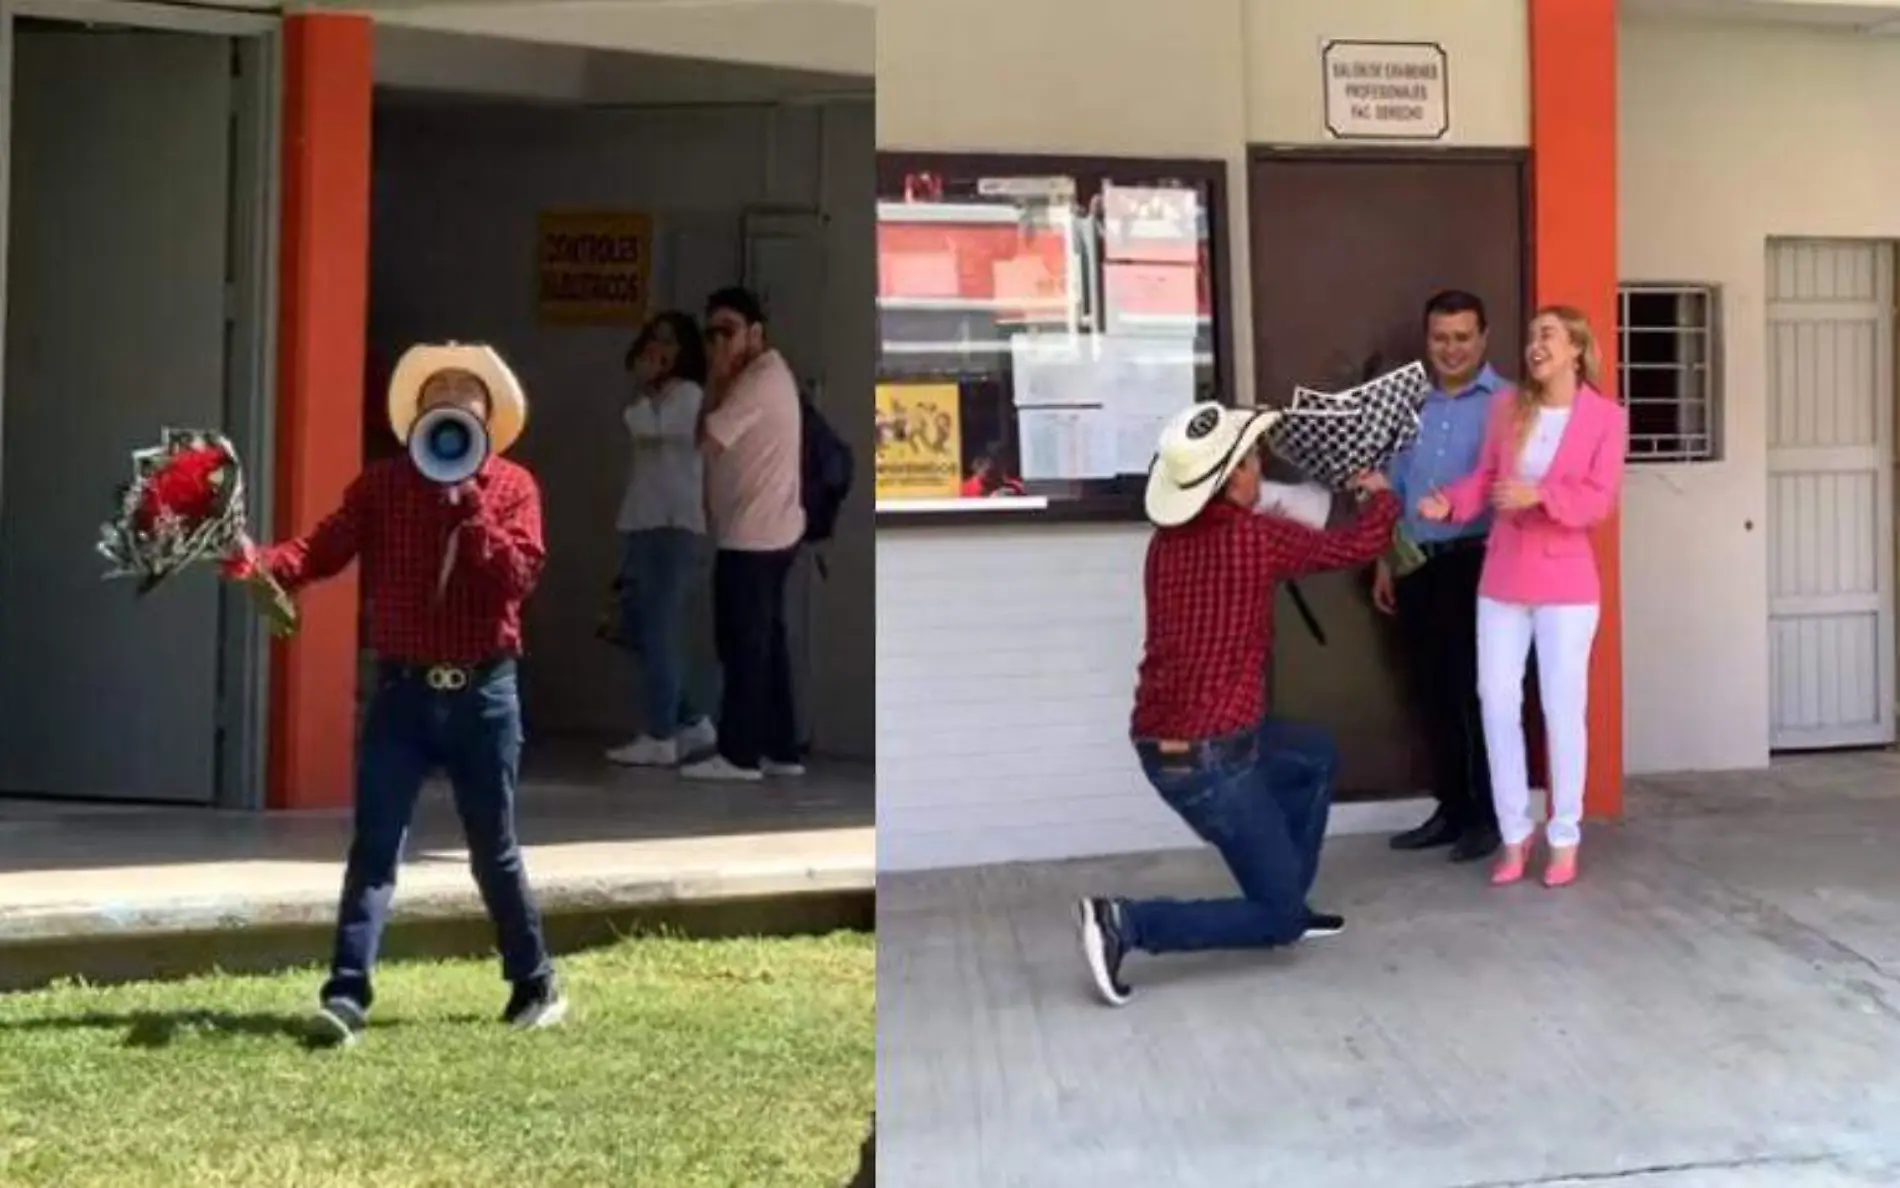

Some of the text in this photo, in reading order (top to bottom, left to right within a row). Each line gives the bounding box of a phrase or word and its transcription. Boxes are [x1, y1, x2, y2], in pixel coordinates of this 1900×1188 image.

[1345, 84, 1428, 100] PROFESIONALES
[1375, 105, 1423, 120] DERECHO
[545, 233, 637, 263] CONTROLES
